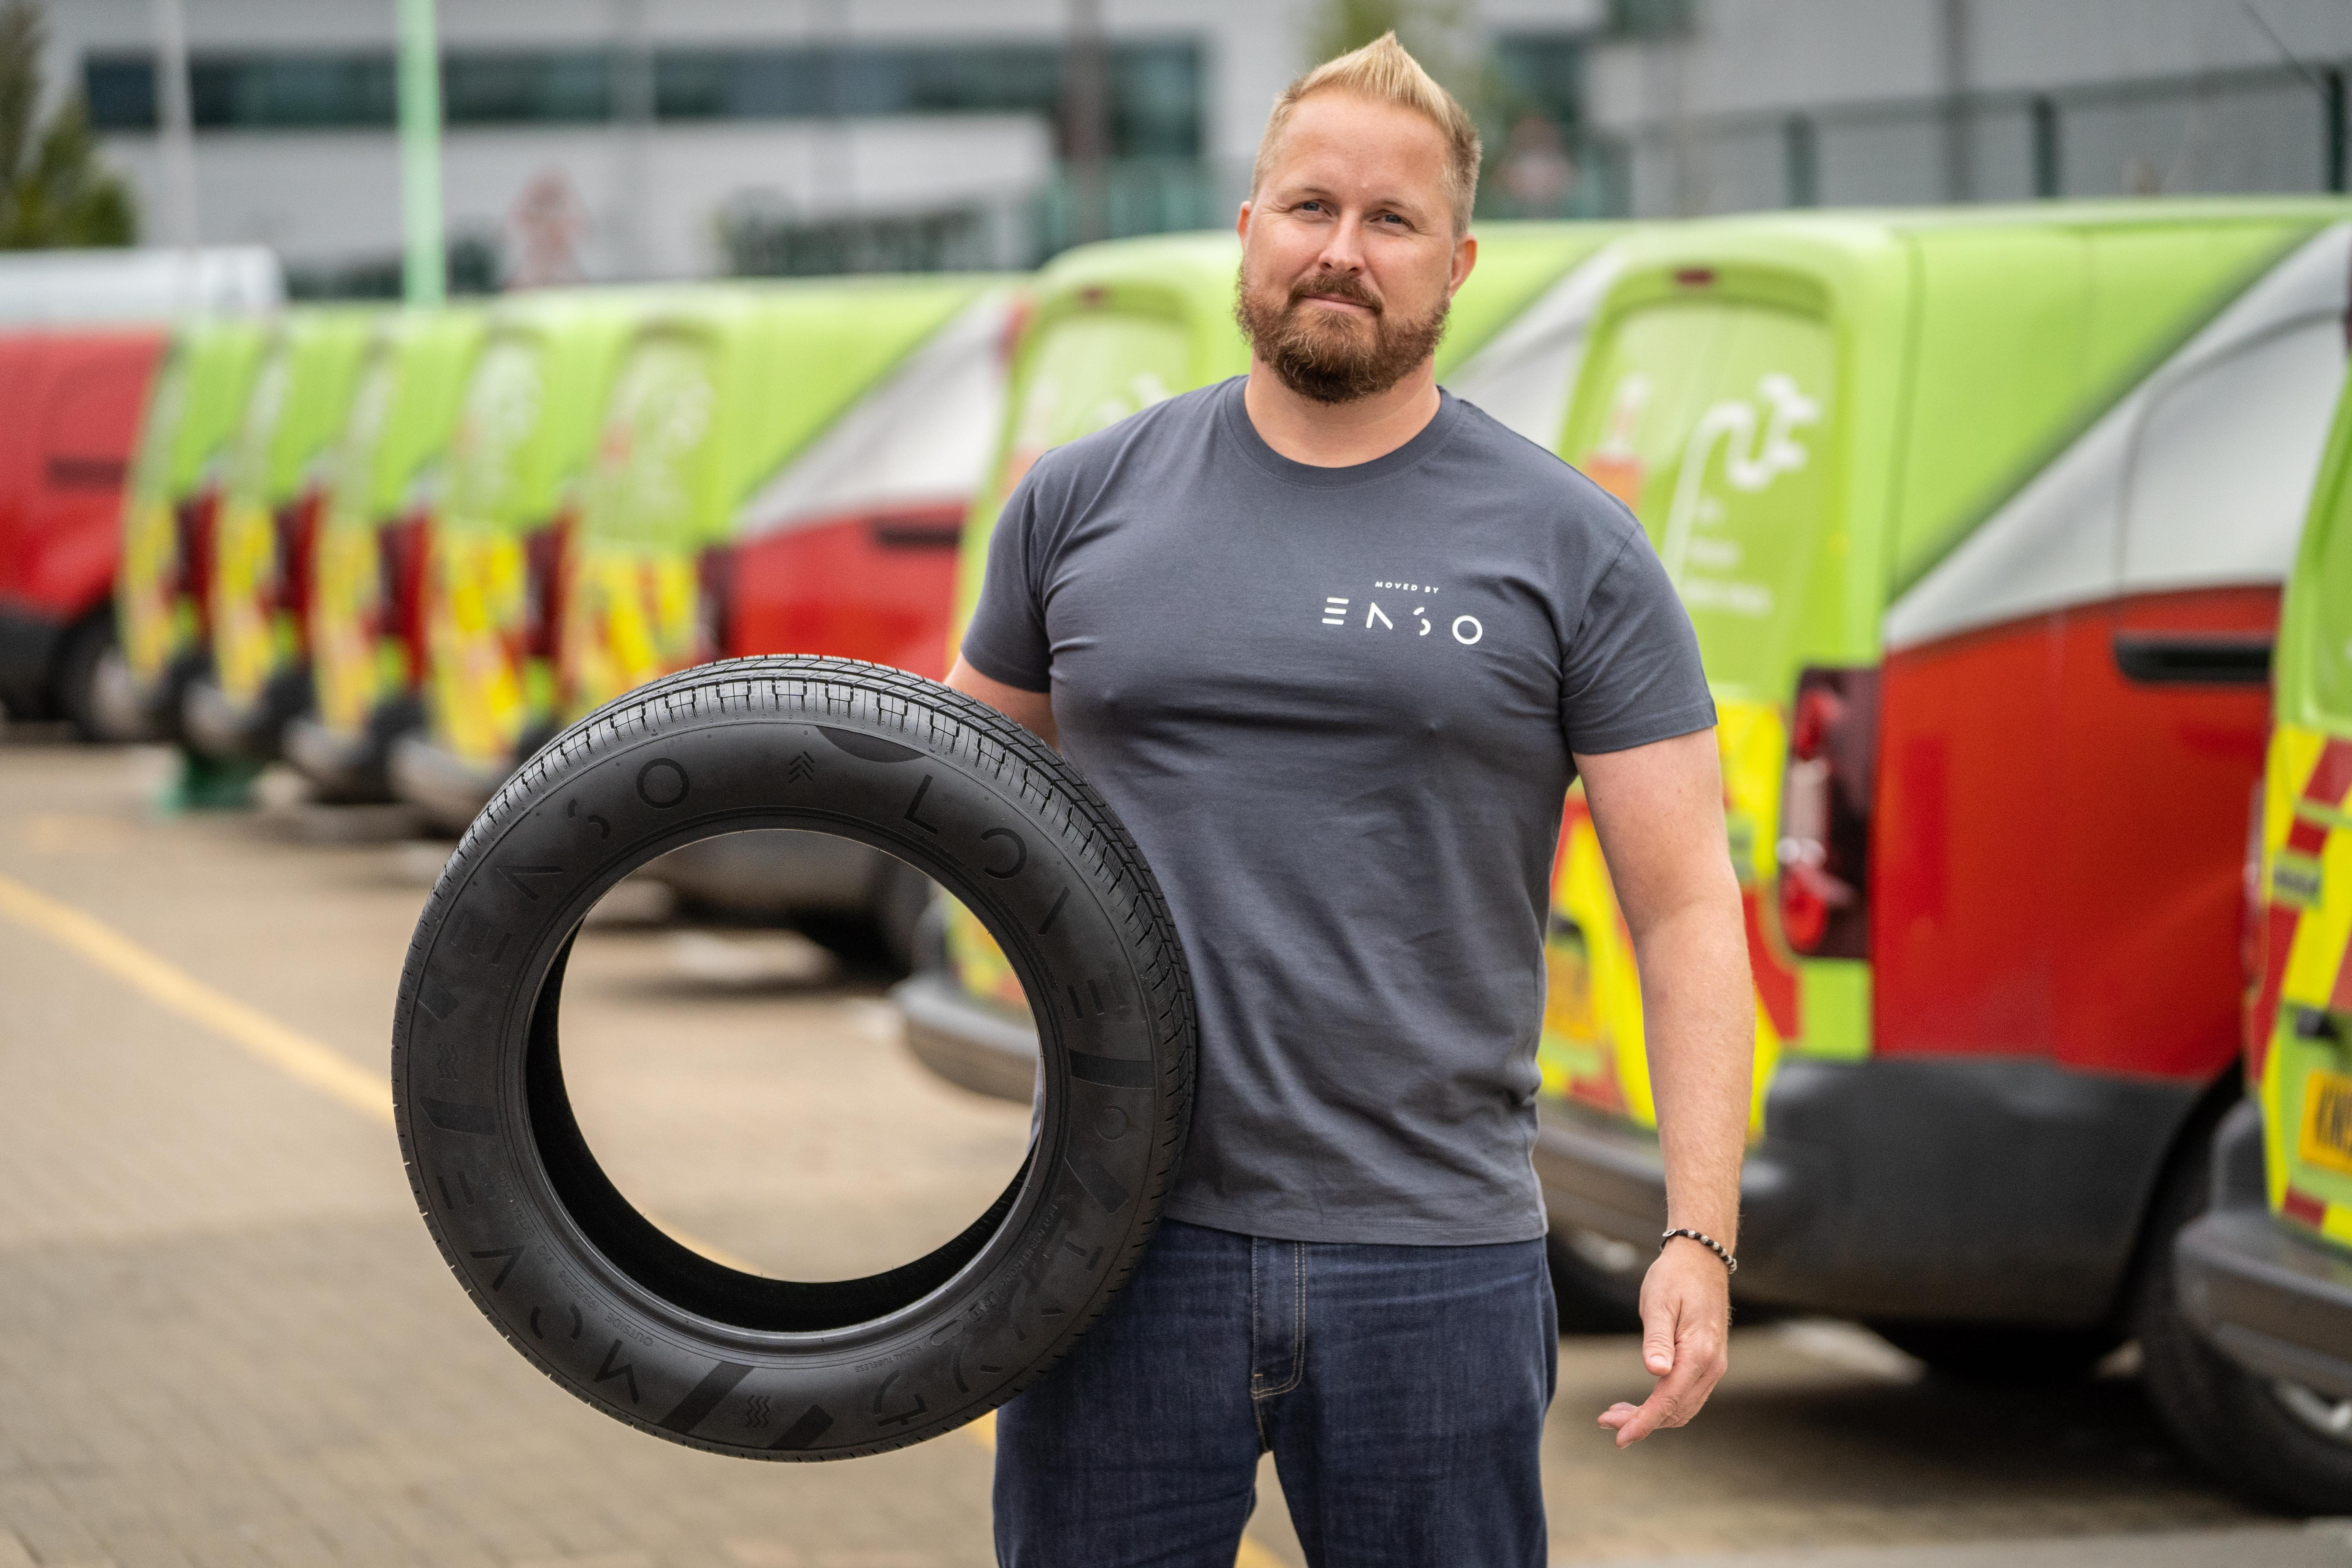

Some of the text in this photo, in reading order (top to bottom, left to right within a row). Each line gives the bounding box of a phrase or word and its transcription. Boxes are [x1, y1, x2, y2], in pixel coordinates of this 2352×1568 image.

[1375, 581, 1418, 591] MOVED
[1321, 597, 1483, 645] ENSO
[605, 1313, 654, 1347] OUTSIDE
[855, 1345, 922, 1373] RADIAL TUBELESS
